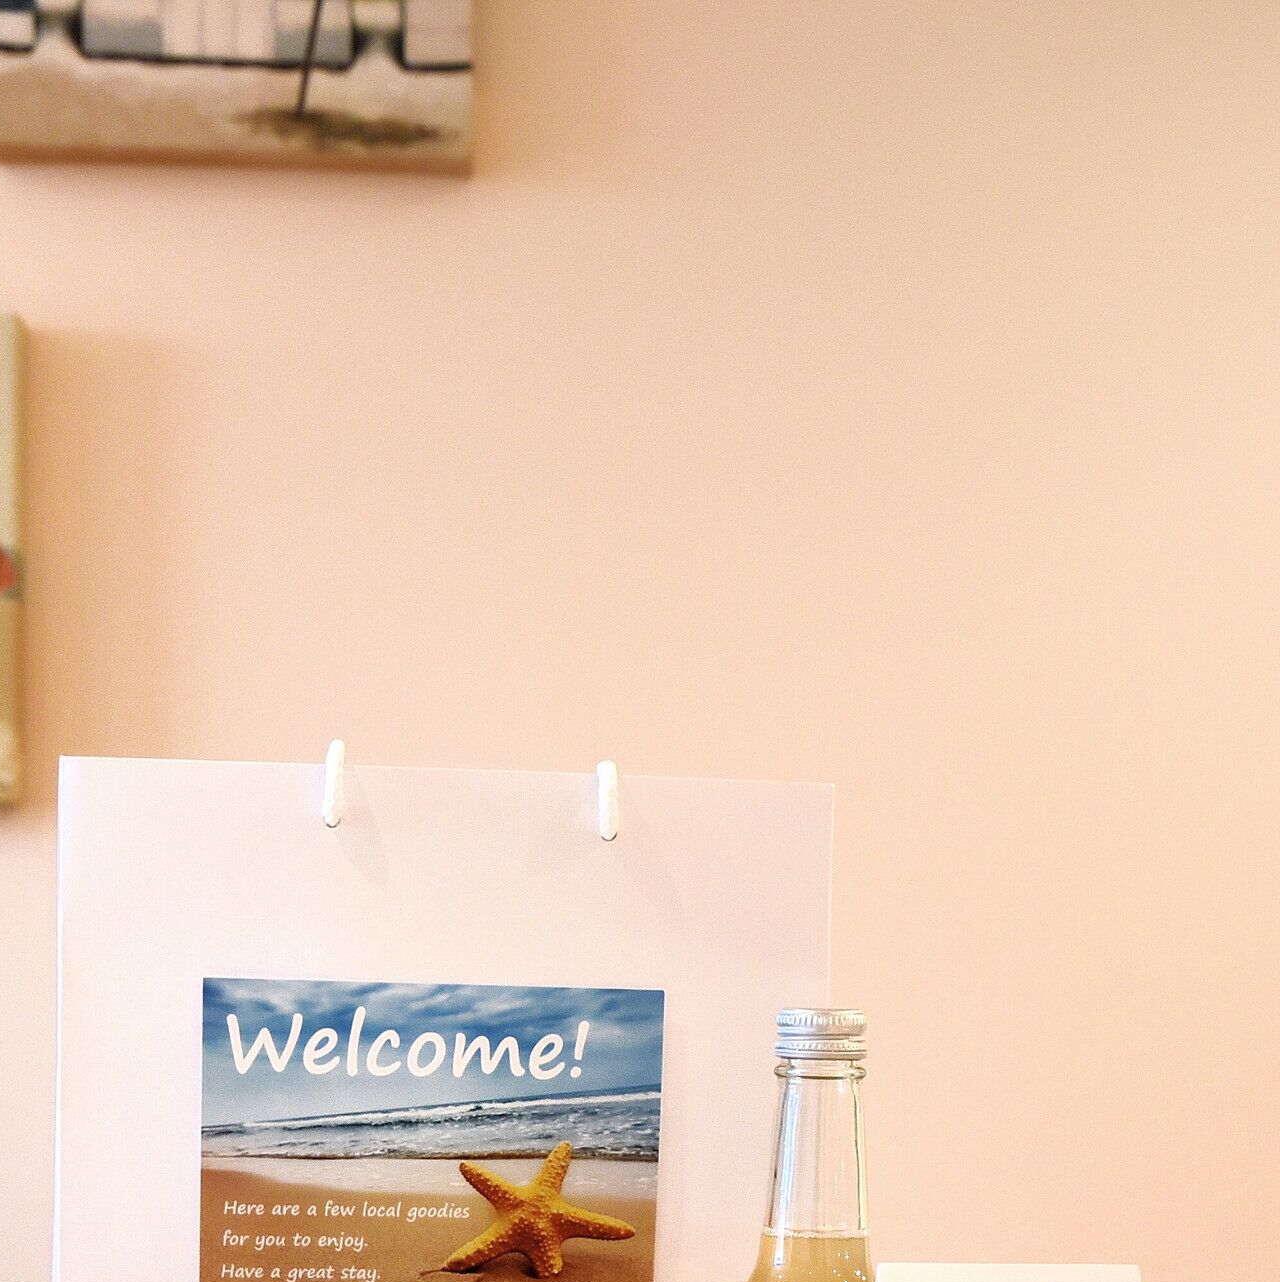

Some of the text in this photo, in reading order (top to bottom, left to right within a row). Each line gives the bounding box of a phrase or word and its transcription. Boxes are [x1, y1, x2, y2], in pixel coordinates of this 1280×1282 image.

[226, 1006, 590, 1080] Welcome!
[223, 1200, 471, 1223] Here are a few local goodies
[222, 1230, 369, 1254] for you to enjoy.
[221, 1263, 265, 1280] Have
[271, 1266, 282, 1279] a
